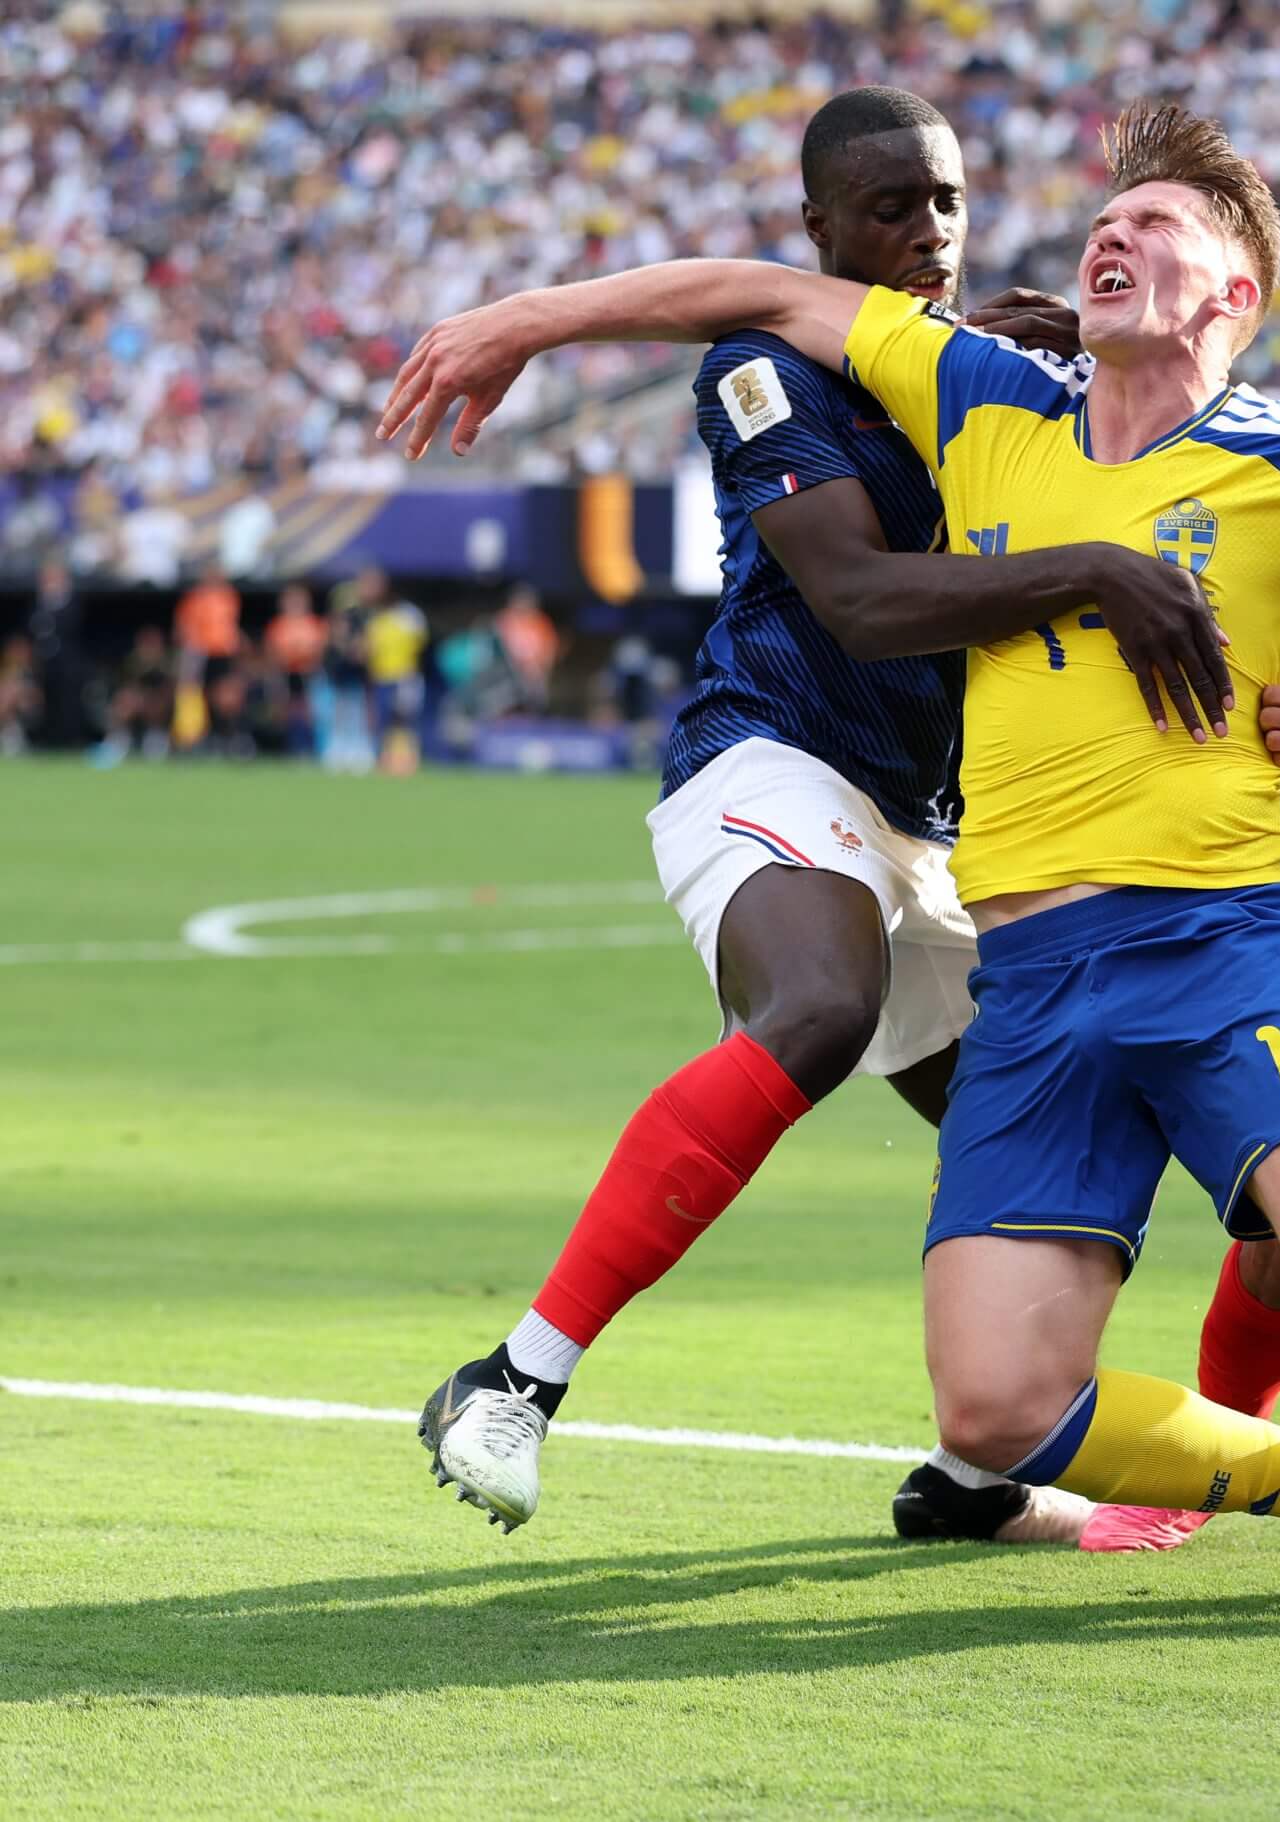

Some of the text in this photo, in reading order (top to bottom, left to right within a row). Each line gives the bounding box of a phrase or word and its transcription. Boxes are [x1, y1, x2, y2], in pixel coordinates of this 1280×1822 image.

[750, 411, 776, 430] 2026
[1163, 519, 1208, 529] SVERIGE
[1197, 1469, 1232, 1512] ERIGE
